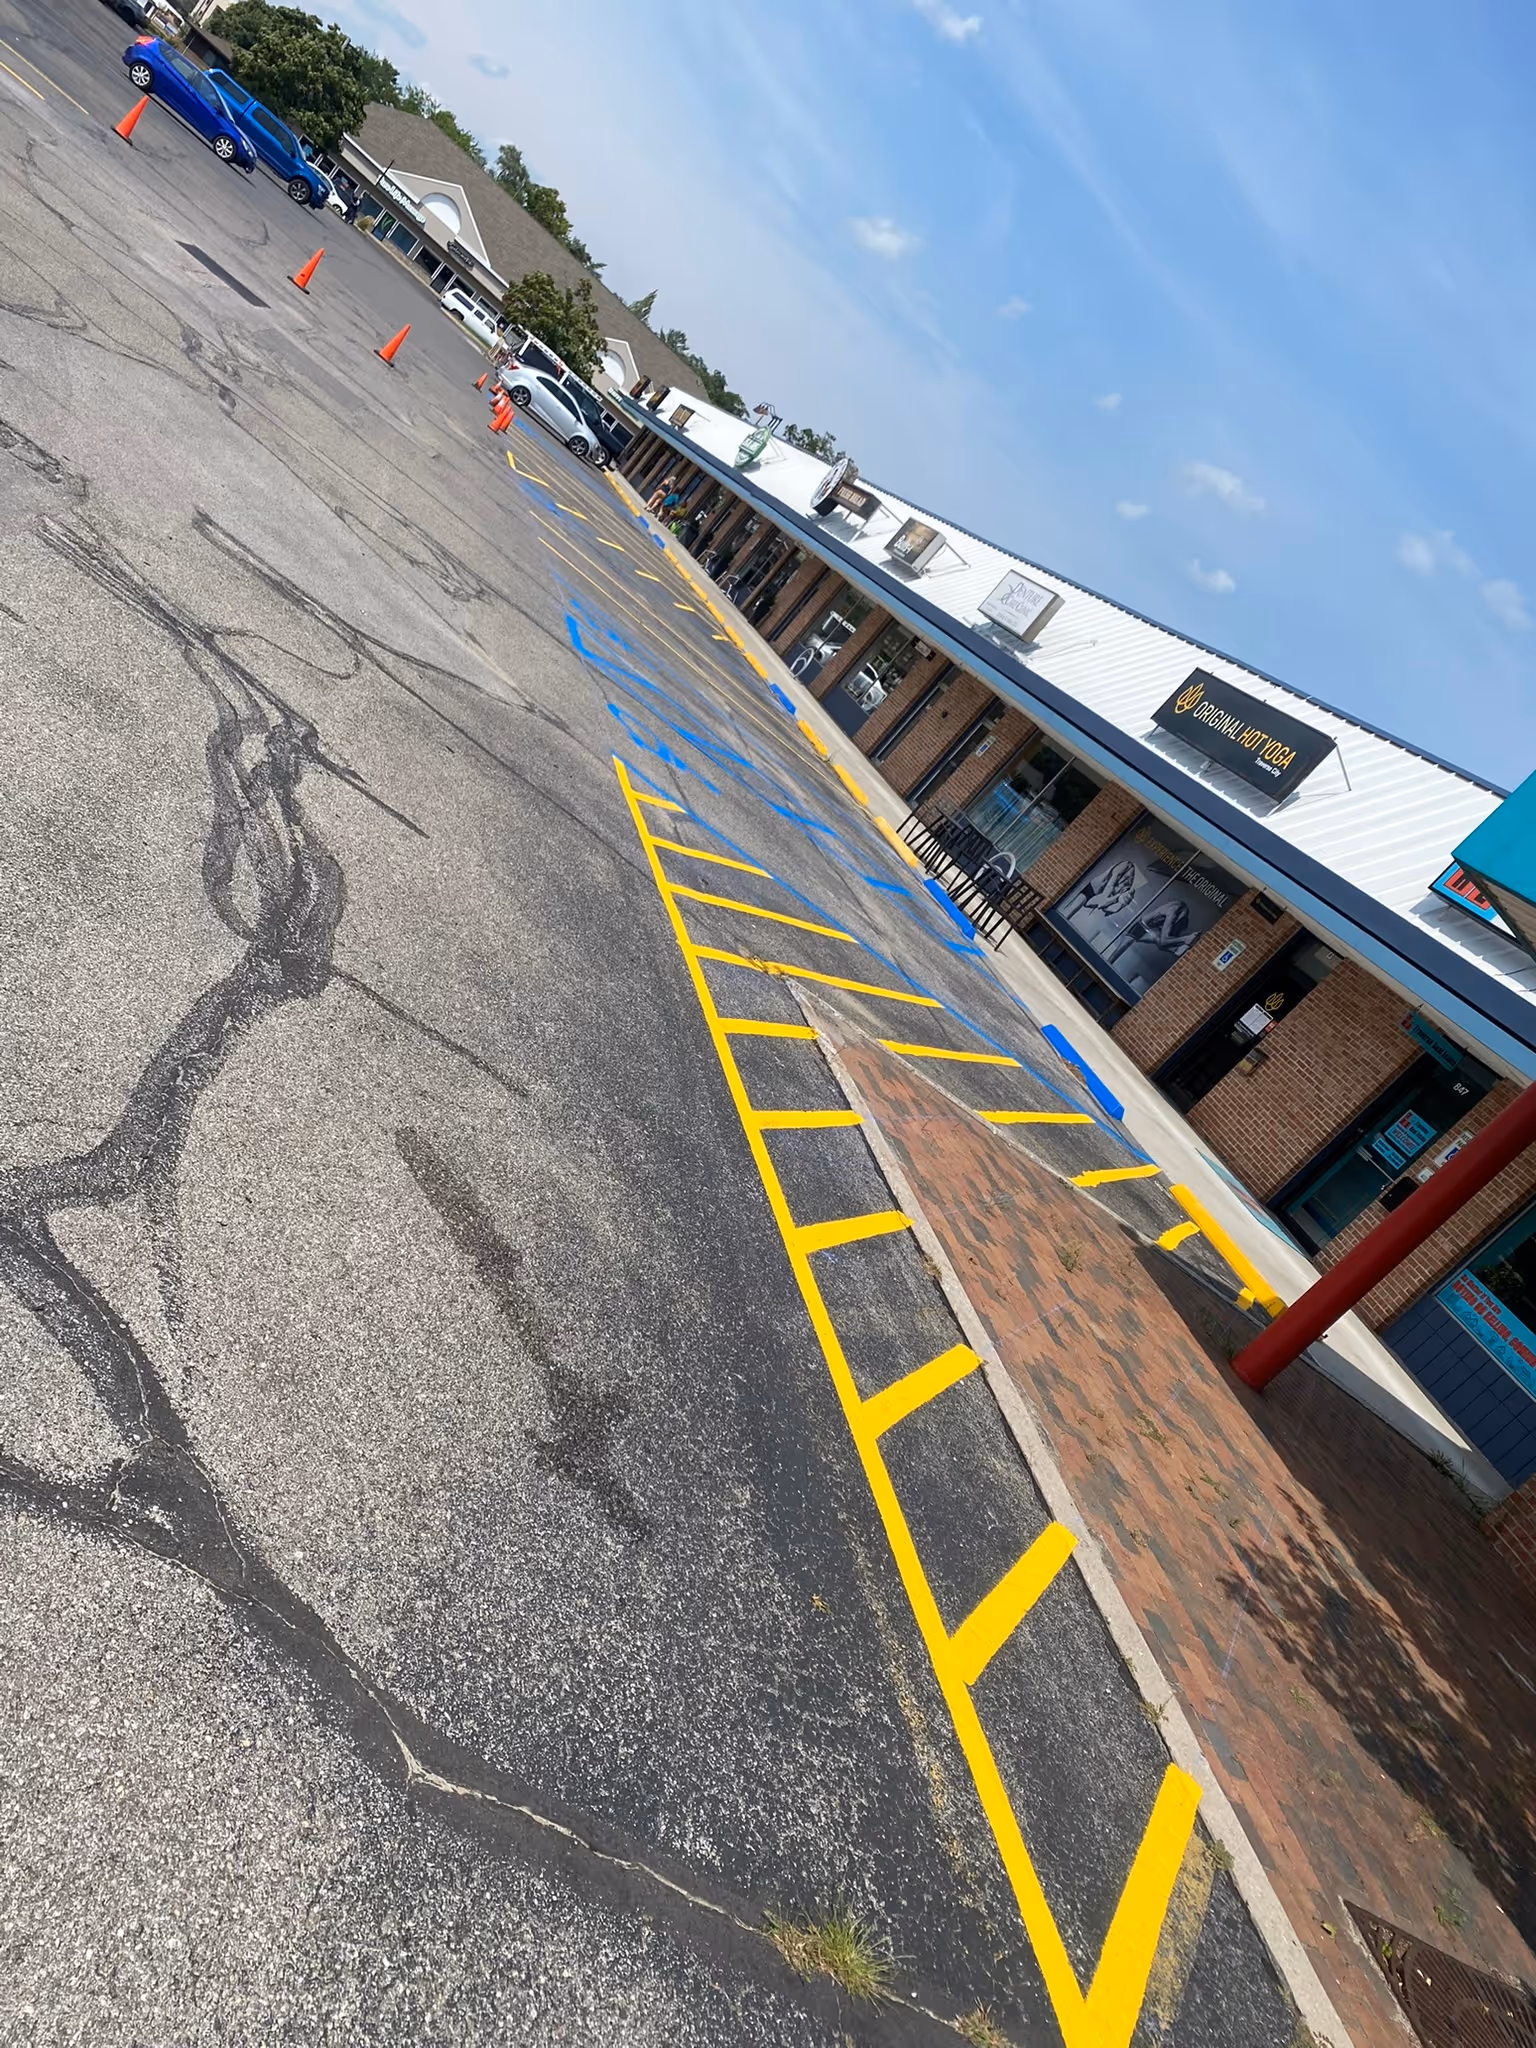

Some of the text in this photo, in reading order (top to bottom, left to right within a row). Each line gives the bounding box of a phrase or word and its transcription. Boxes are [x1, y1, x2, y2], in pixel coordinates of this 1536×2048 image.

[1193, 701, 1296, 770] ORIGINAL HOT YOGA
[1255, 757, 1282, 778] Traverse City
[1182, 866, 1200, 884] THE
[1194, 876, 1228, 908] ORIGINAL
[1452, 1082, 1470, 1096] 847
